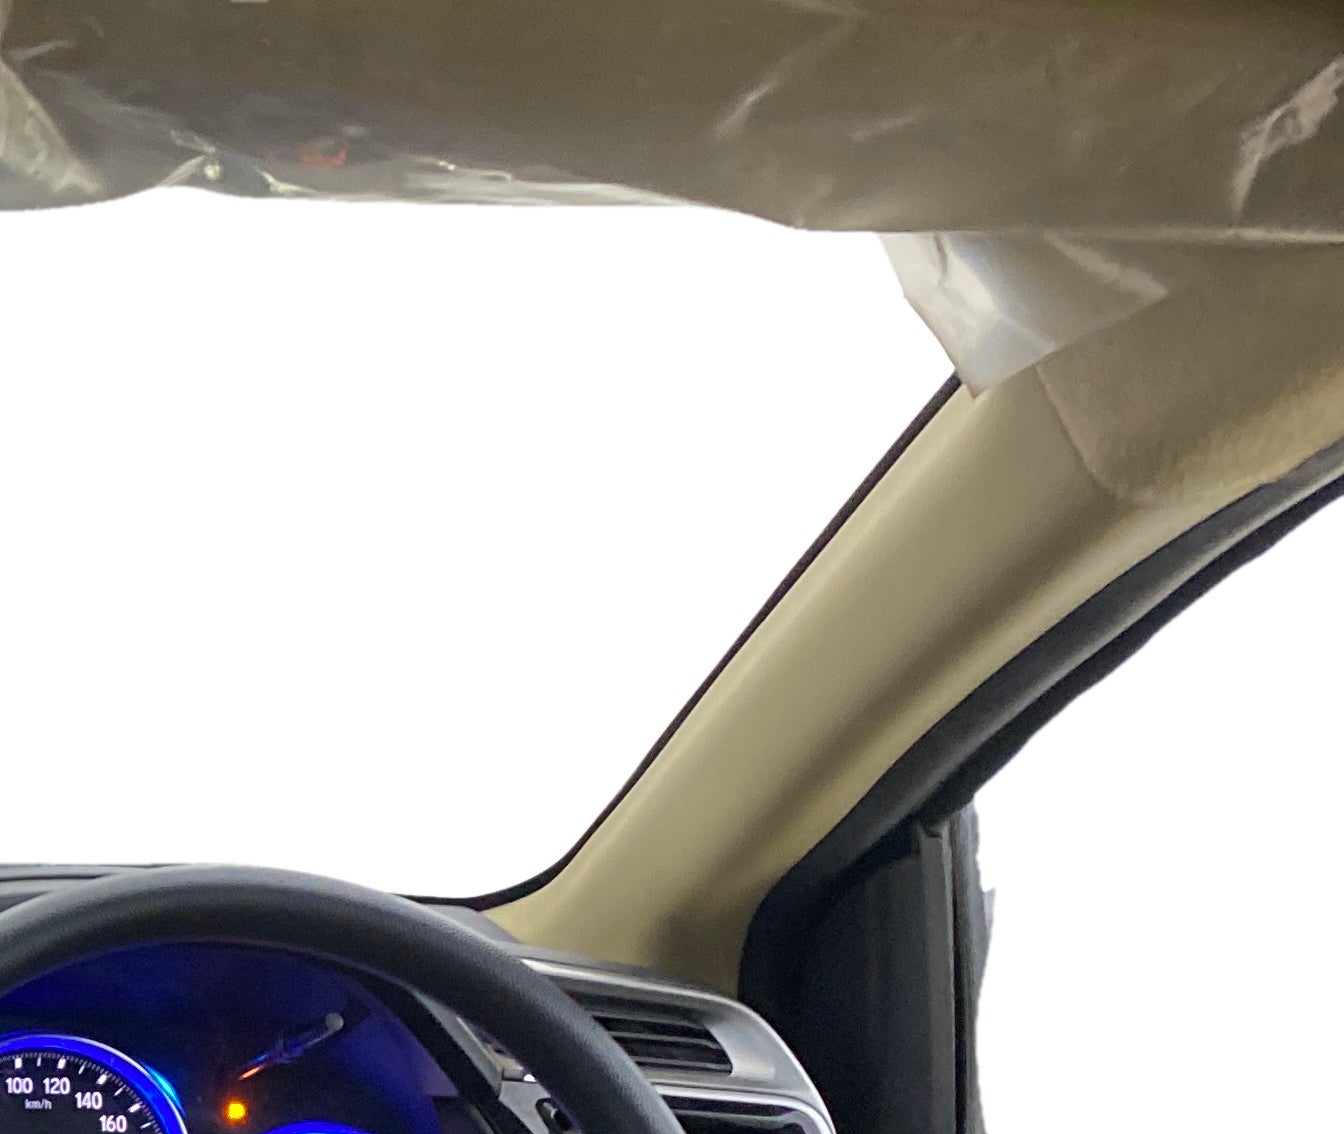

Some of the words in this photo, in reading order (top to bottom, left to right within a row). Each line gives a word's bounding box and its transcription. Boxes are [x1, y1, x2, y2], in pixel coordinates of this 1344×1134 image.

[5, 1077, 33, 1094] 100
[43, 1077, 70, 1094] 120
[25, 1099, 52, 1109] km/h
[75, 1091, 103, 1110] 140
[99, 1114, 127, 1132] 160
